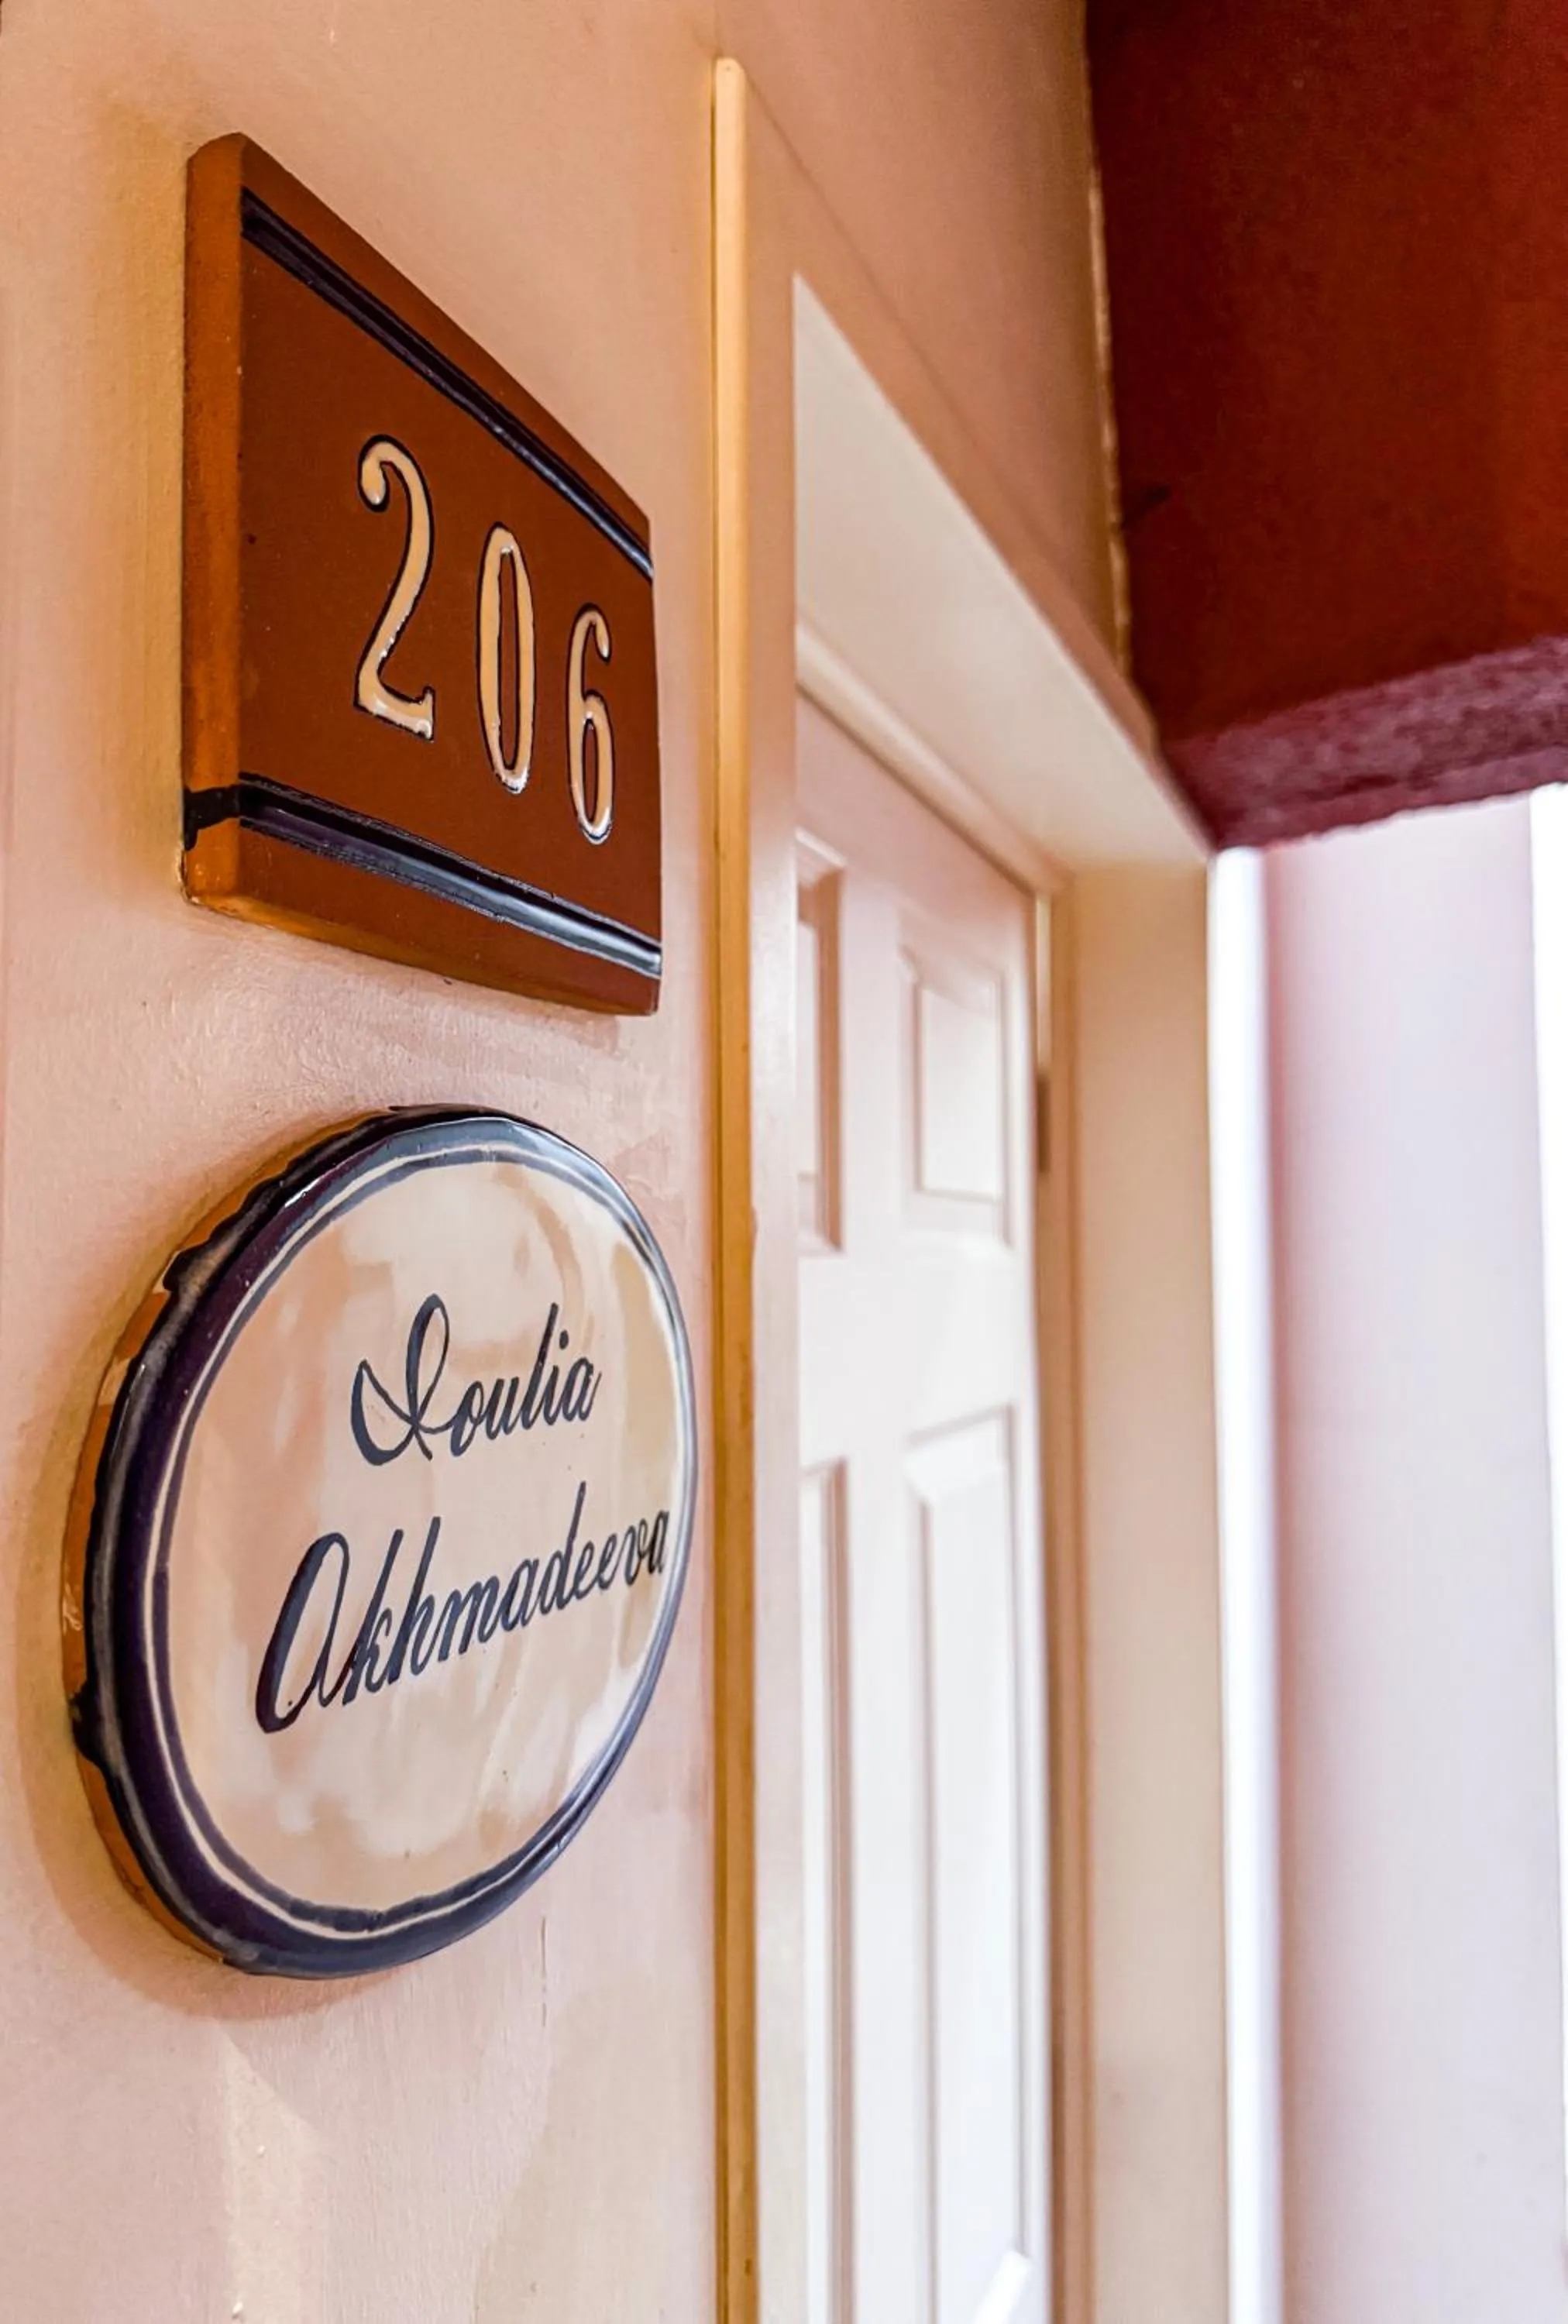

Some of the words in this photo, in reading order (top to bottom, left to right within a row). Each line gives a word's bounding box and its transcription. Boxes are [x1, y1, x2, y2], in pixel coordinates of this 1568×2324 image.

[354, 434, 614, 844] 206
[350, 1293, 602, 1466] Ioulia
[255, 1480, 670, 1734] Akhmadeeva
